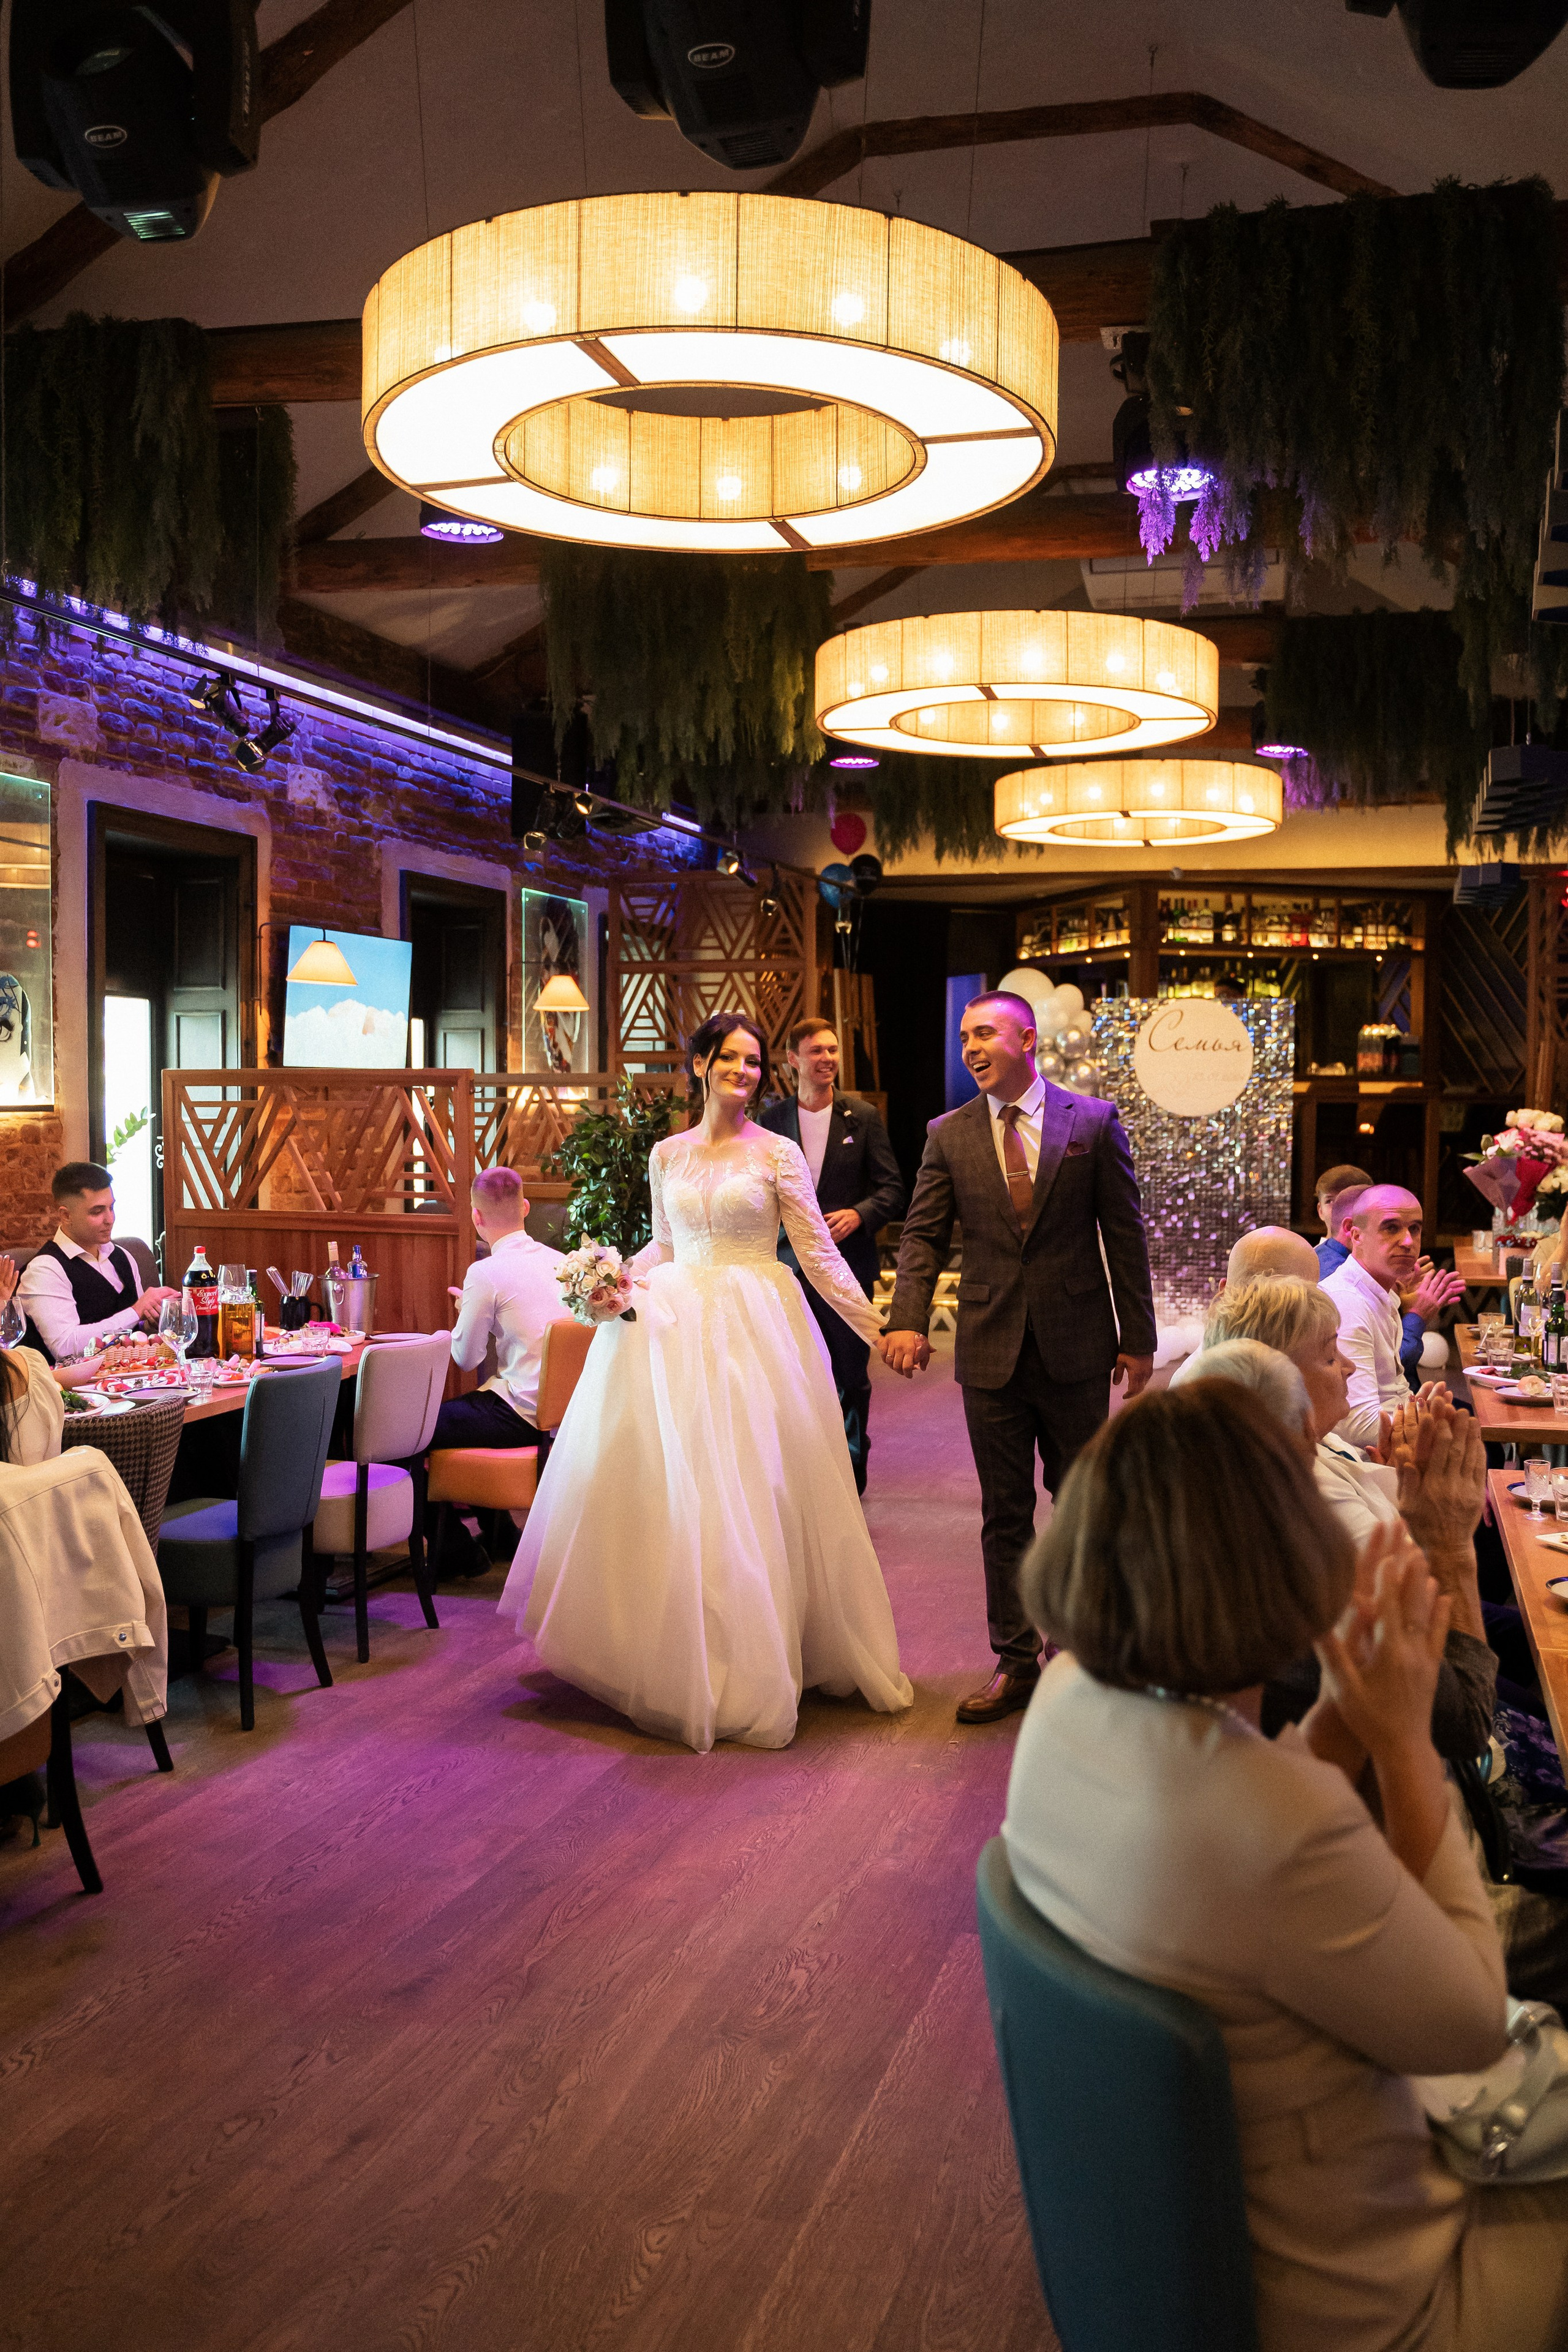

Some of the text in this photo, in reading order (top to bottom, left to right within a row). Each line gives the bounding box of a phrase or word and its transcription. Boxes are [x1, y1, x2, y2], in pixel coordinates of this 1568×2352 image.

[694, 48, 729, 62] BEAM
[90, 131, 122, 142] BEAM
[1149, 1008, 1246, 1052] Семья
[197, 1289, 217, 1300] Export
[200, 1296, 215, 1306] Style
